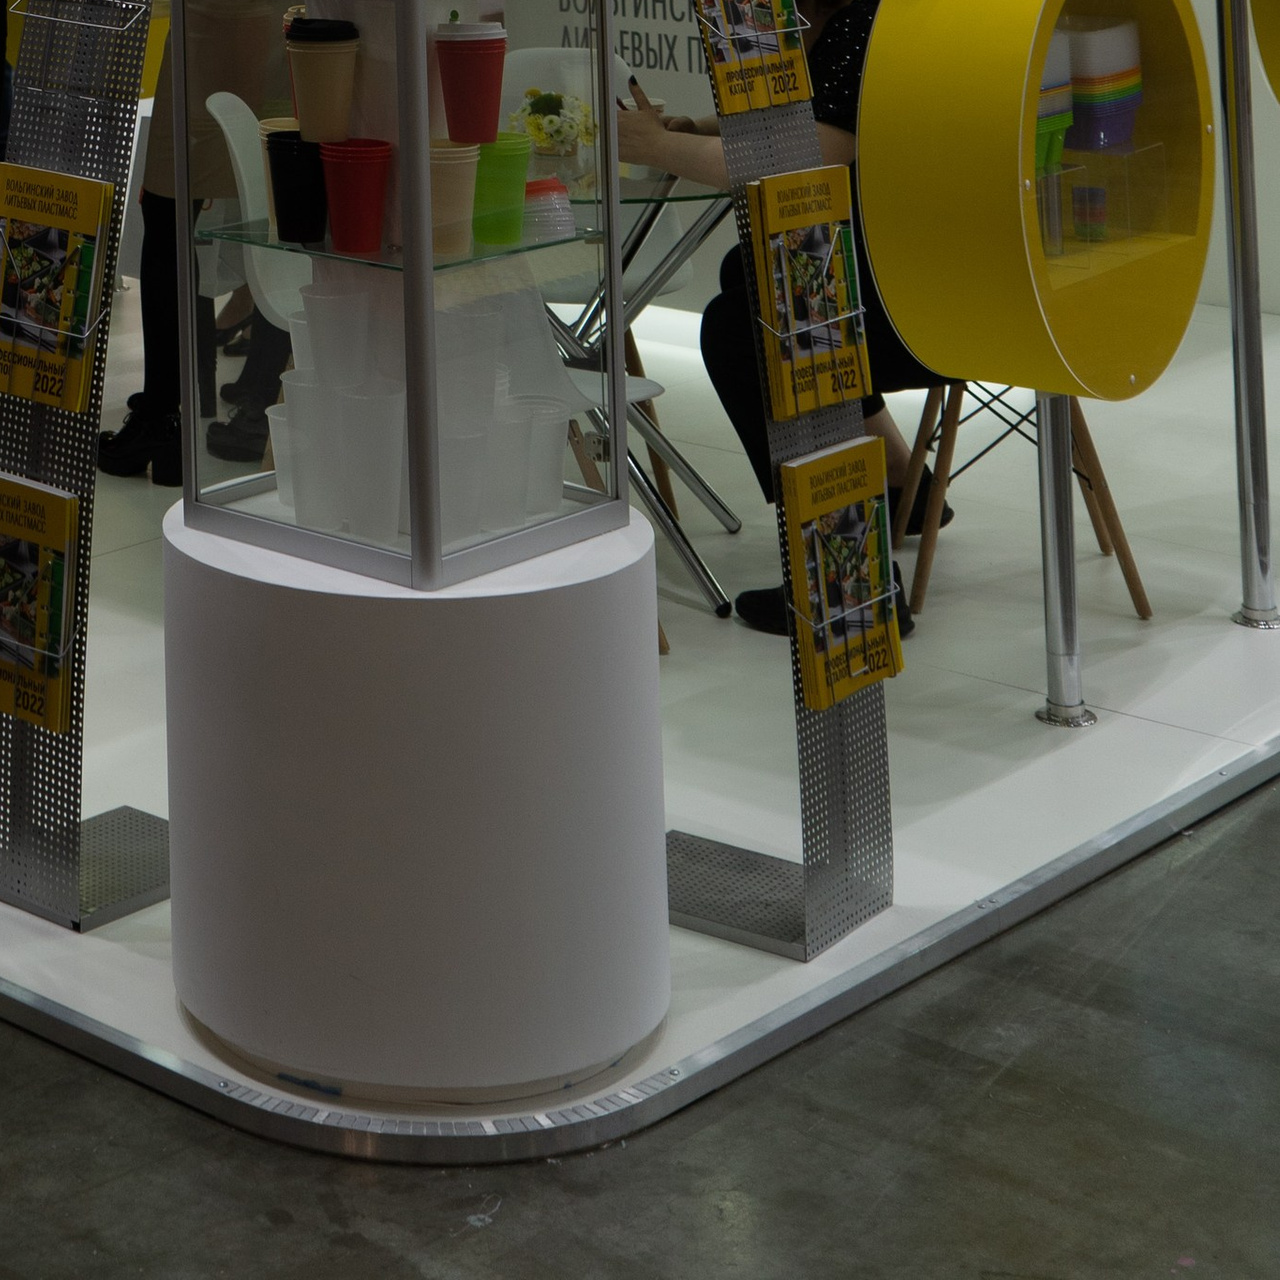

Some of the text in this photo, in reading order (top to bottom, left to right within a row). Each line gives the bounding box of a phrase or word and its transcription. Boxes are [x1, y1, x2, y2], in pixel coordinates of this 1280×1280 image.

[772, 73, 800, 94] 2022
[6, 179, 78, 205] ВОЛЬГИНСКИЙ ЗАВОД
[4, 193, 78, 221] ЛИТЬЕВЫХ ПЛАСТМАСС
[34, 372, 64, 397] 2022
[831, 369, 858, 393] 2022
[23, 498, 46, 519] ЗАВОД
[5, 510, 46, 534] ПЛАСТМАСС
[15, 689, 46, 717] 2022
